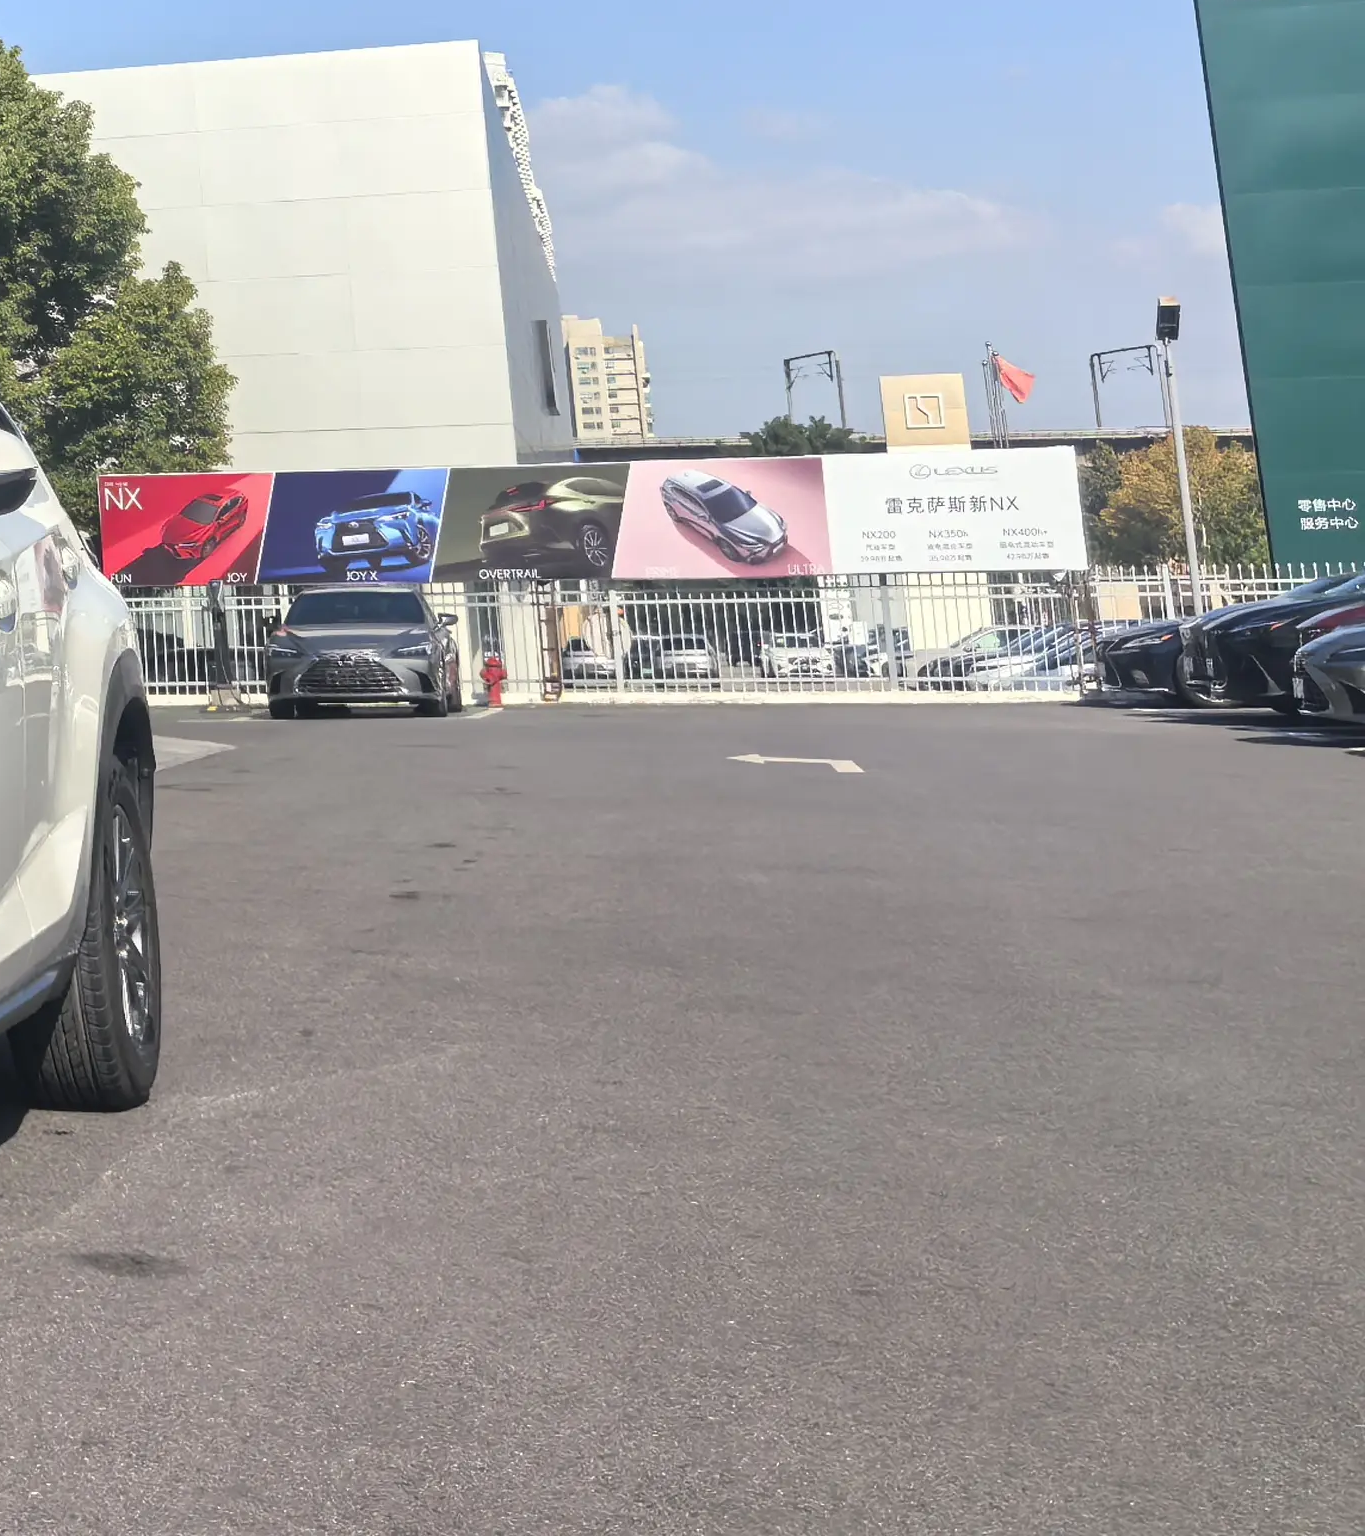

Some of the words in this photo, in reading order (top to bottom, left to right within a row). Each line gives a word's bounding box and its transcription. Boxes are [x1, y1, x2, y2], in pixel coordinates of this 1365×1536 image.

[104, 487, 144, 511] NX
[885, 495, 1020, 515] 雷克萨斯新NX
[1297, 497, 1357, 512] 零售中心
[1300, 516, 1360, 531] 服务中心
[861, 530, 897, 540] NX200
[478, 568, 541, 580] OVERTRAIL
[787, 563, 826, 575] ULTRA
[110, 573, 132, 583] FUN
[226, 572, 248, 583] JOY
[346, 571, 368, 581] JOY
[370, 571, 379, 581] X
